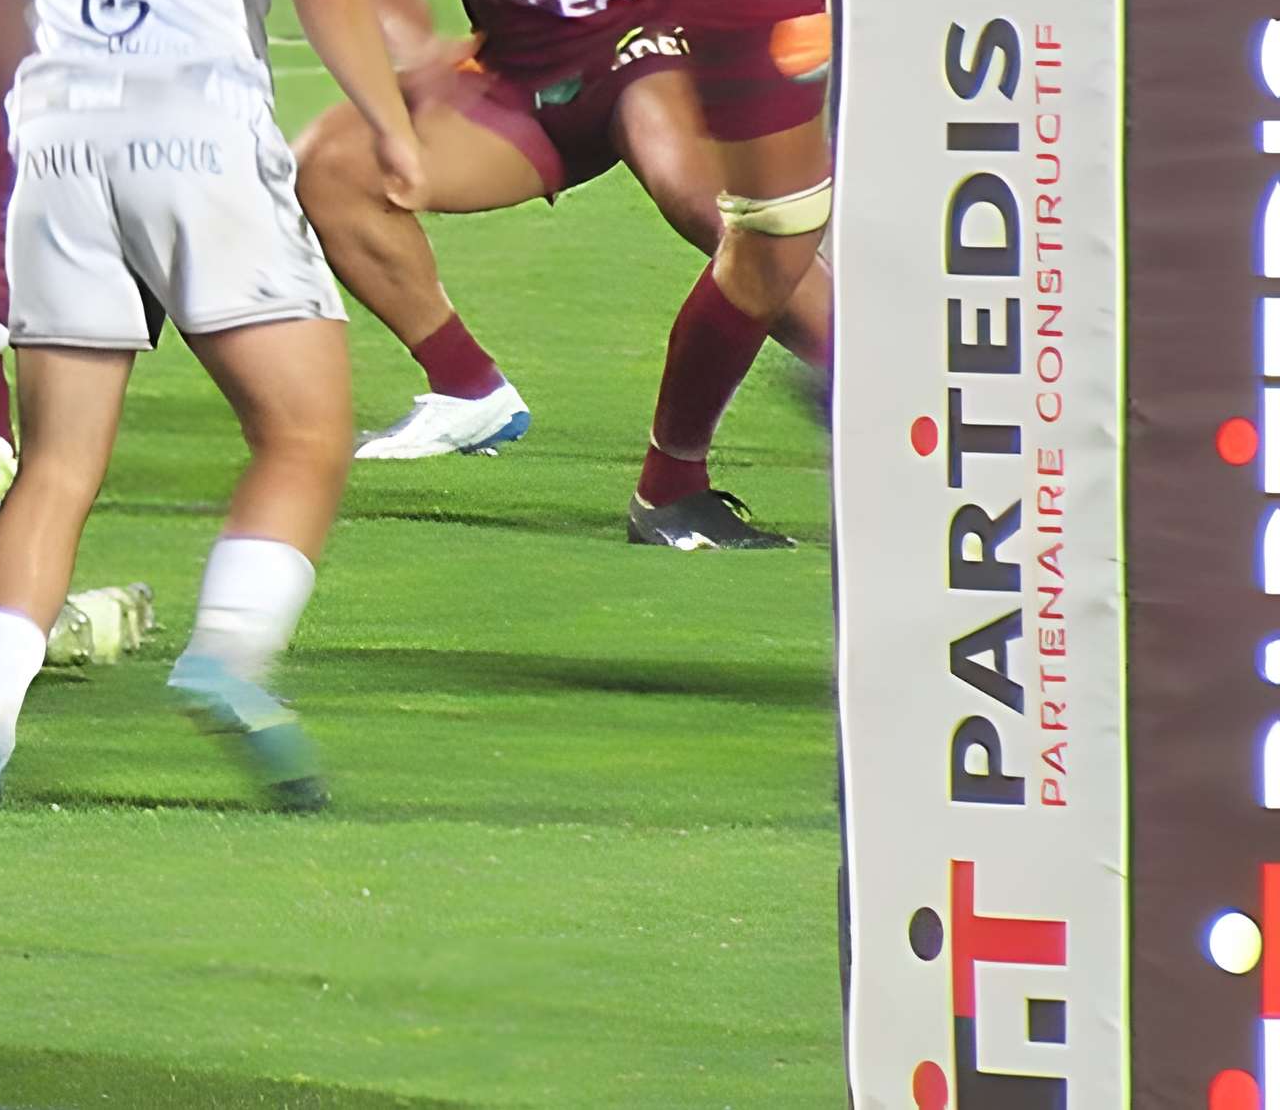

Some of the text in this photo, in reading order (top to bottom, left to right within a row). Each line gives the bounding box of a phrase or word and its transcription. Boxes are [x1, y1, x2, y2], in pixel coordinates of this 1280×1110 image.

[946, 18, 1025, 805] PARTEDIS
[1035, 23, 1067, 806] PARTENAIRE CONSTRUCTIF
